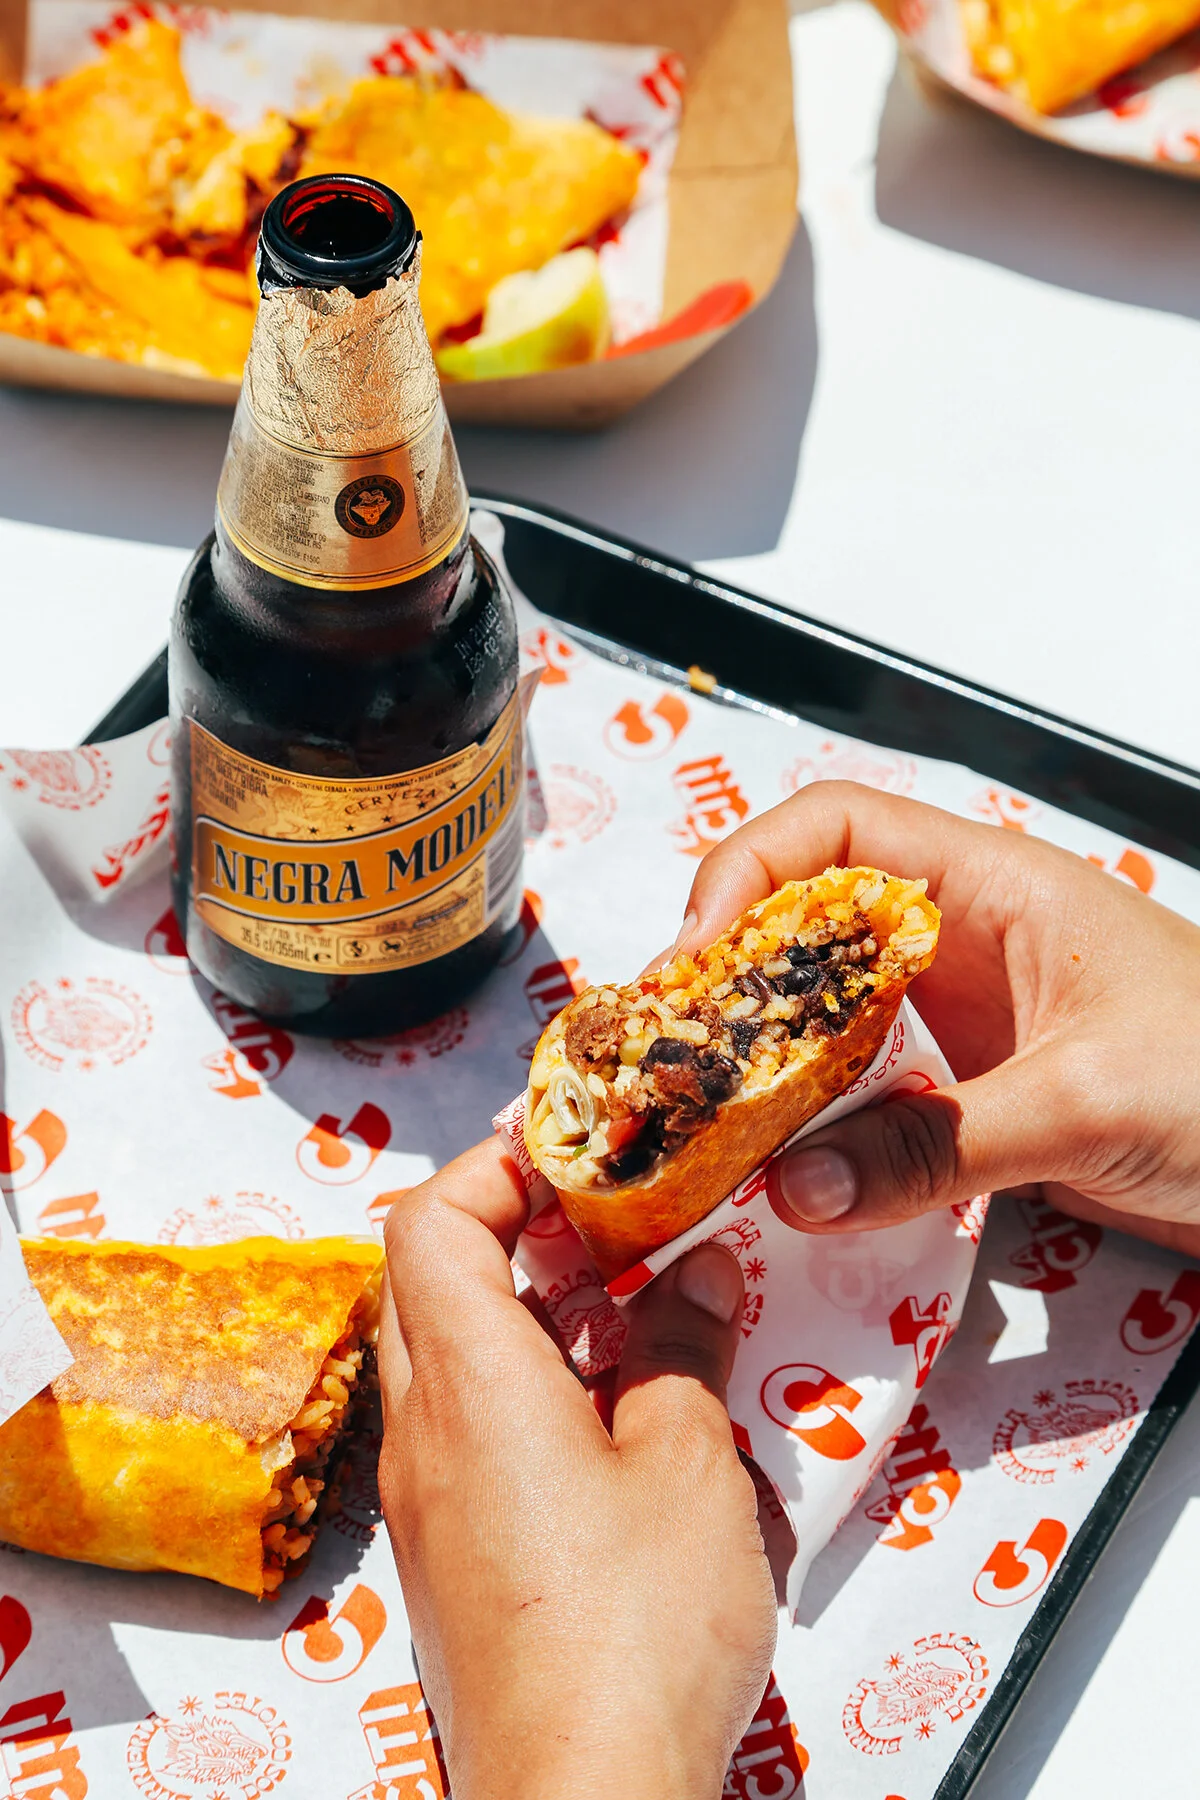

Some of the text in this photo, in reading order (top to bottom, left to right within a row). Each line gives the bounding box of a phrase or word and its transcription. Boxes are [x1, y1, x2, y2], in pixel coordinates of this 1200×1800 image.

[212, 841, 368, 906] NEGRA
[384, 735, 516, 895] MODEL
[344, 788, 436, 816] CERVEZA
[236, 1191, 306, 1240] OYOTES
[913, 1632, 991, 1683] COYOTES
[214, 1690, 293, 1763] COYOTES
[842, 1678, 904, 1756] BIRRIERIA
[944, 1684, 988, 1724] DOS
